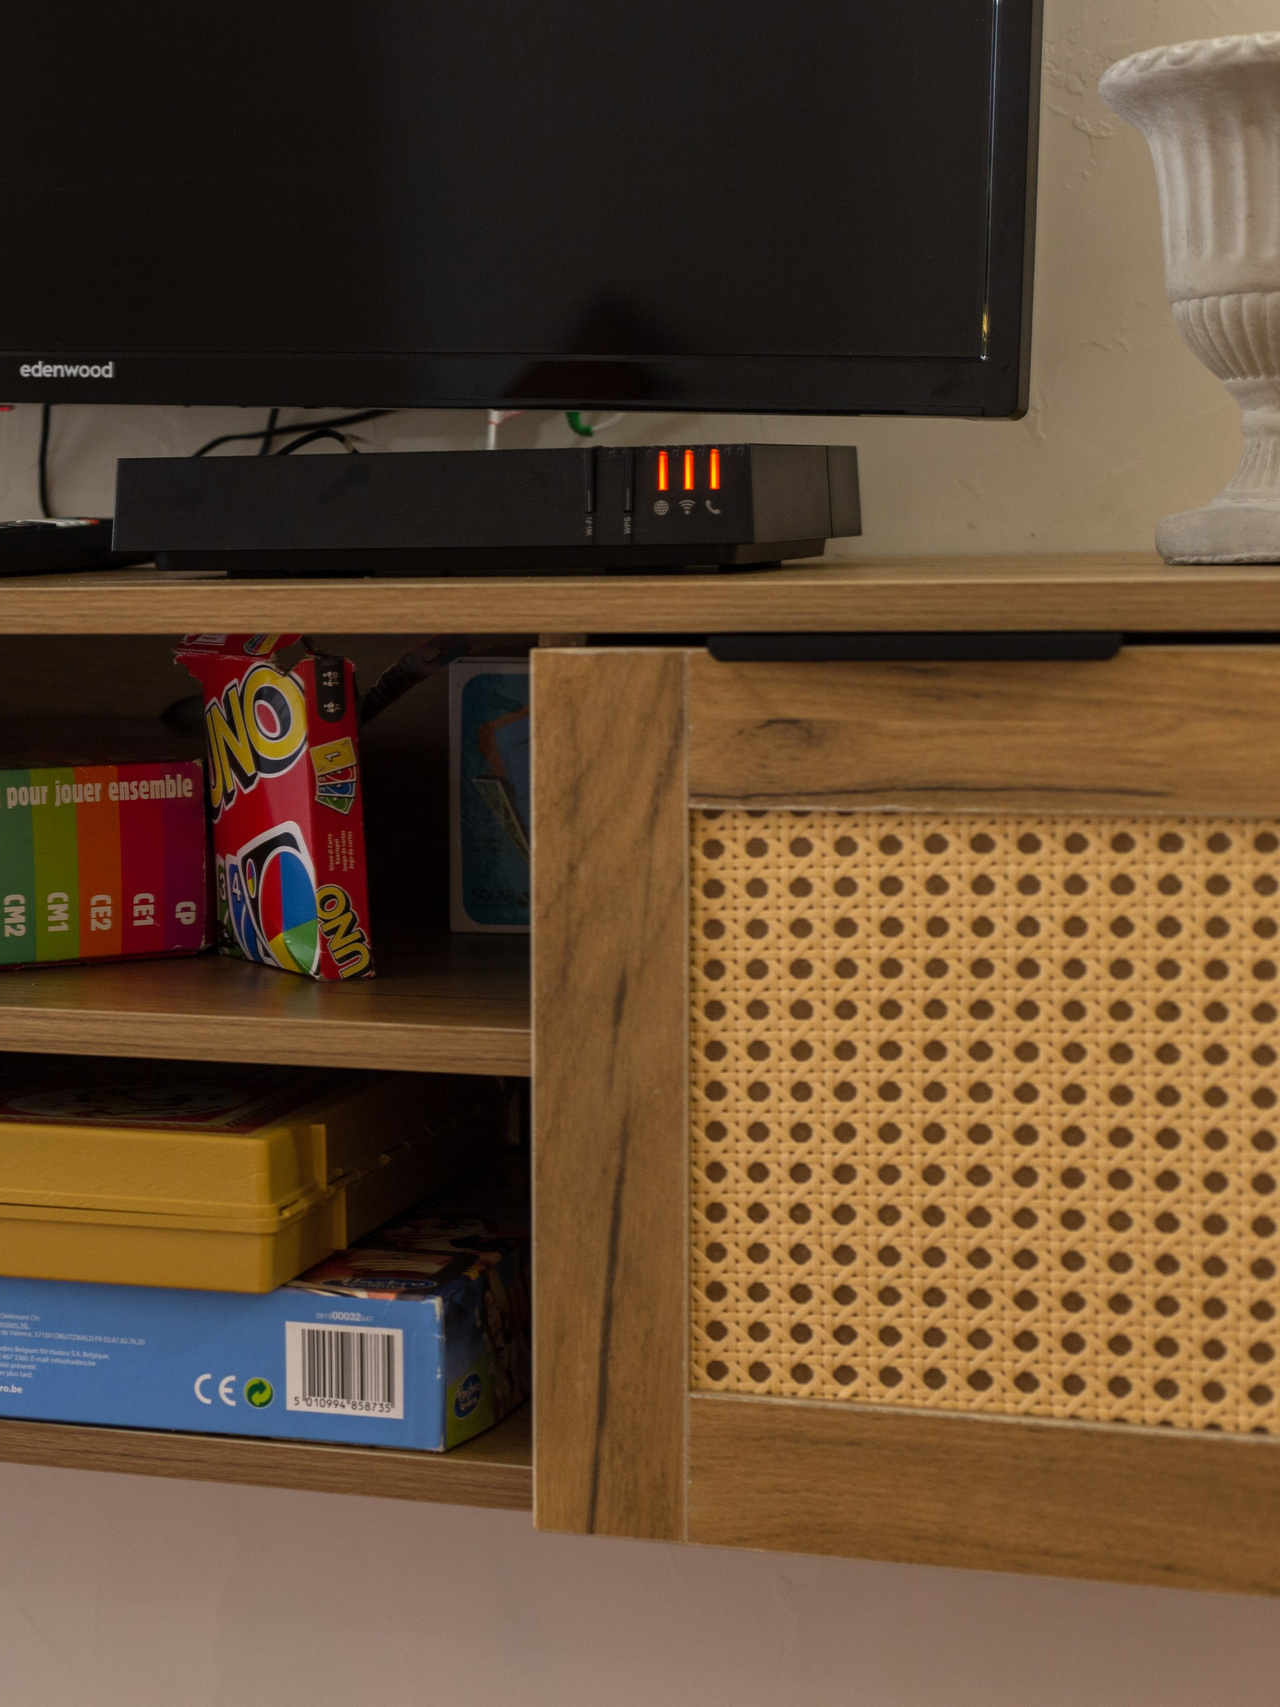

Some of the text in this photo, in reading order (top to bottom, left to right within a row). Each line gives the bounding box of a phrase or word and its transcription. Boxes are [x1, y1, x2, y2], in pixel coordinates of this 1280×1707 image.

[20, 360, 114, 378] edenwood
[585, 516, 593, 536] Wi-Fi
[623, 516, 631, 535] WPS
[206, 664, 308, 822] UNO
[324, 751, 340, 762] 1
[7, 785, 48, 809] pour
[54, 780, 101, 807] jouer
[108, 774, 193, 801] ensemble
[219, 872, 226, 901] 3
[232, 872, 241, 901] 4
[3, 894, 25, 937] CM2
[47, 892, 68, 932] CM1
[90, 894, 111, 931] CE2
[133, 892, 154, 926] CE1
[175, 901, 195, 925] CP
[315, 884, 372, 979] UNO
[194, 1373, 236, 1406] CE
[294, 1397, 392, 1414] 5 010994 858735
